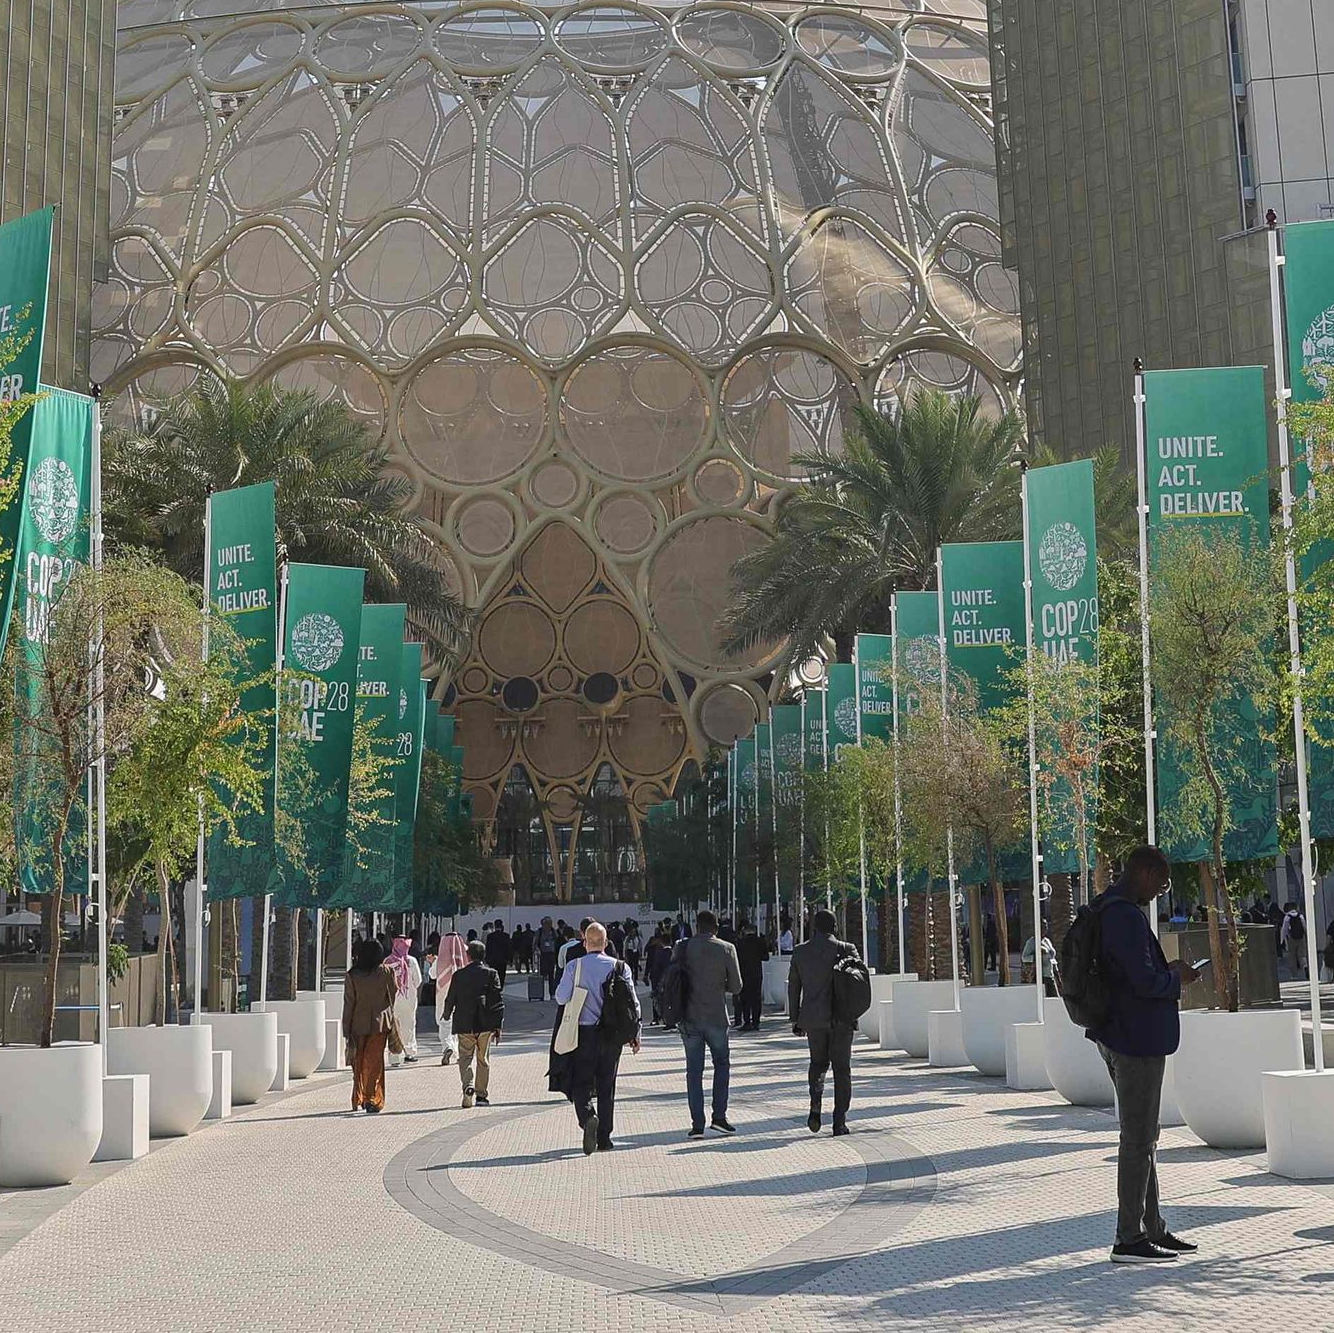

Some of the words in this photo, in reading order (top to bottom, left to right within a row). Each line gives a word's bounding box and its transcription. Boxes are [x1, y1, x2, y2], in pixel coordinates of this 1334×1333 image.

[1158, 436, 1223, 458] UNITE.
[1158, 464, 1202, 487] ACT.
[1160, 491, 1249, 515] DELIVER.
[218, 543, 255, 566] UNITE.
[217, 569, 242, 590] ACT.
[218, 588, 271, 612] DELIVER.
[951, 589, 997, 606] UNITE.
[951, 609, 982, 625] ACT.
[1041, 597, 1099, 638] COP28
[953, 628, 1016, 645] DELIVER.
